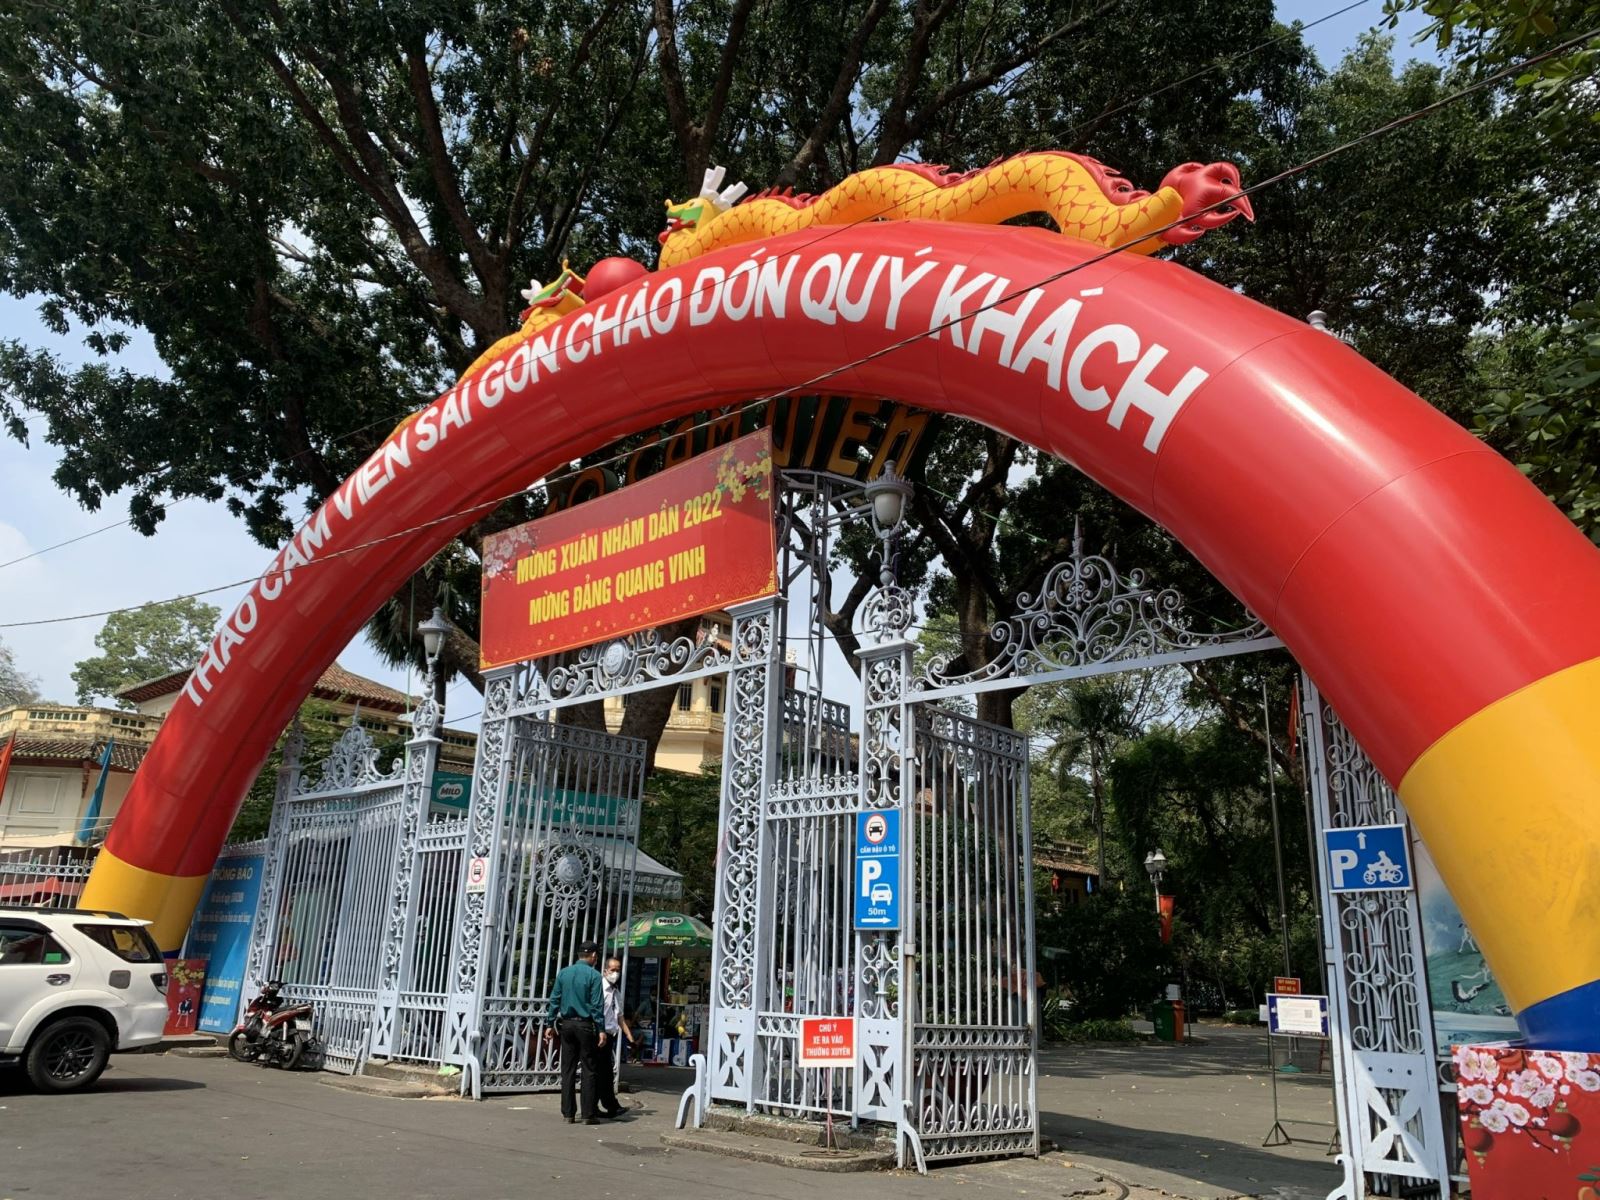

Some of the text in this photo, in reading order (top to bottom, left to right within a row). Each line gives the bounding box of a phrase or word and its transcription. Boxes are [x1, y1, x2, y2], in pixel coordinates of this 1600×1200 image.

[801, 246, 938, 331] QUÝ
[928, 264, 1209, 454] KHÁCH
[560, 533, 598, 571] XUÂN
[602, 517, 644, 558] NHÂM
[683, 489, 723, 529] 2022
[573, 574, 611, 613] ĐẢNG
[616, 560, 664, 602] QUANG
[669, 544, 706, 584] VINH
[862, 860, 882, 897] P
[1330, 849, 1358, 888] P
[868, 908, 886, 916] 50m
